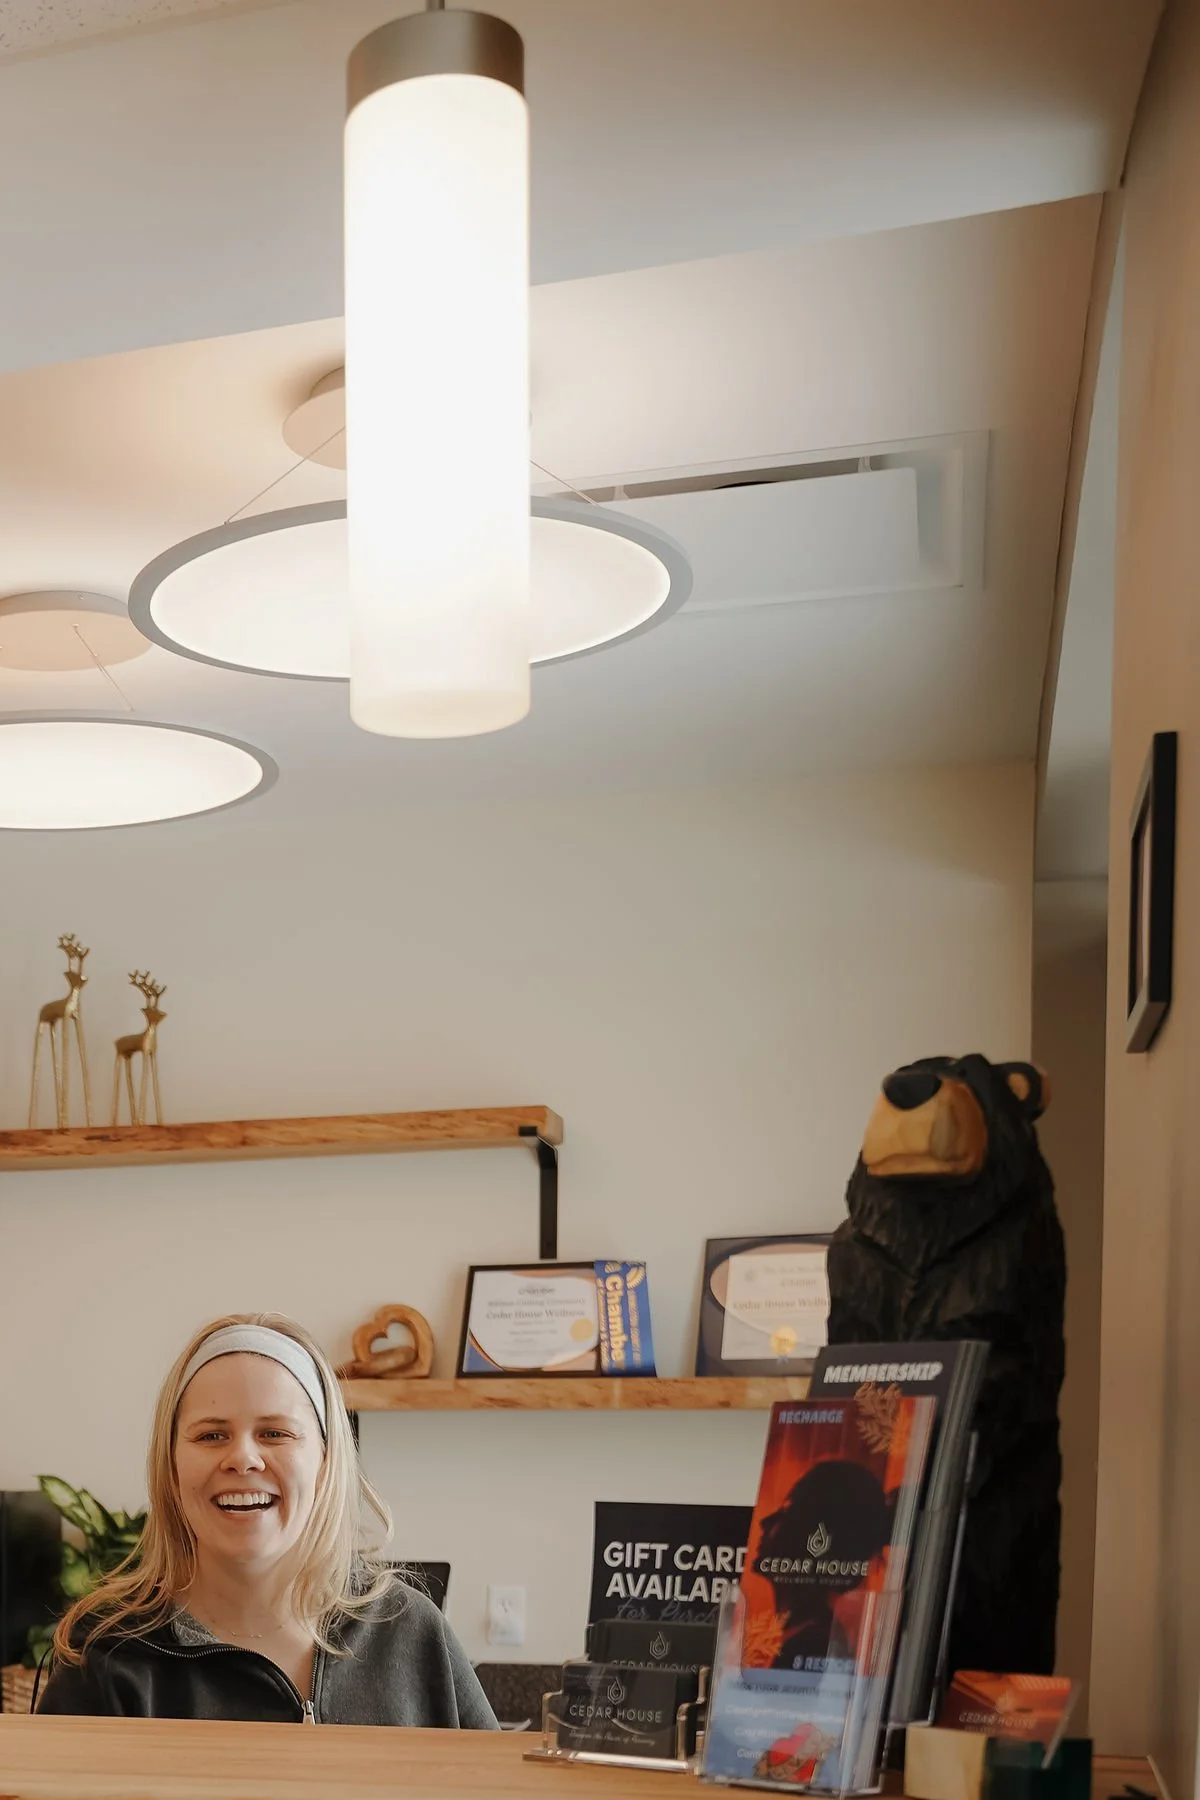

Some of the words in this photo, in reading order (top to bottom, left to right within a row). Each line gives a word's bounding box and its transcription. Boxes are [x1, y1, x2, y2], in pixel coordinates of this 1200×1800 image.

[823, 1361, 943, 1384] MEMBERSHIP
[778, 1409, 845, 1425] RECHARGE
[603, 1541, 670, 1569] GIFT
[759, 1557, 809, 1574] CEDAR
[815, 1559, 869, 1577] HOUSE
[659, 1662, 699, 1674] HOUS
[569, 1704, 612, 1719] CEDAR
[617, 1708, 663, 1723] HOUSE
[959, 1712, 997, 1725] CEDAR
